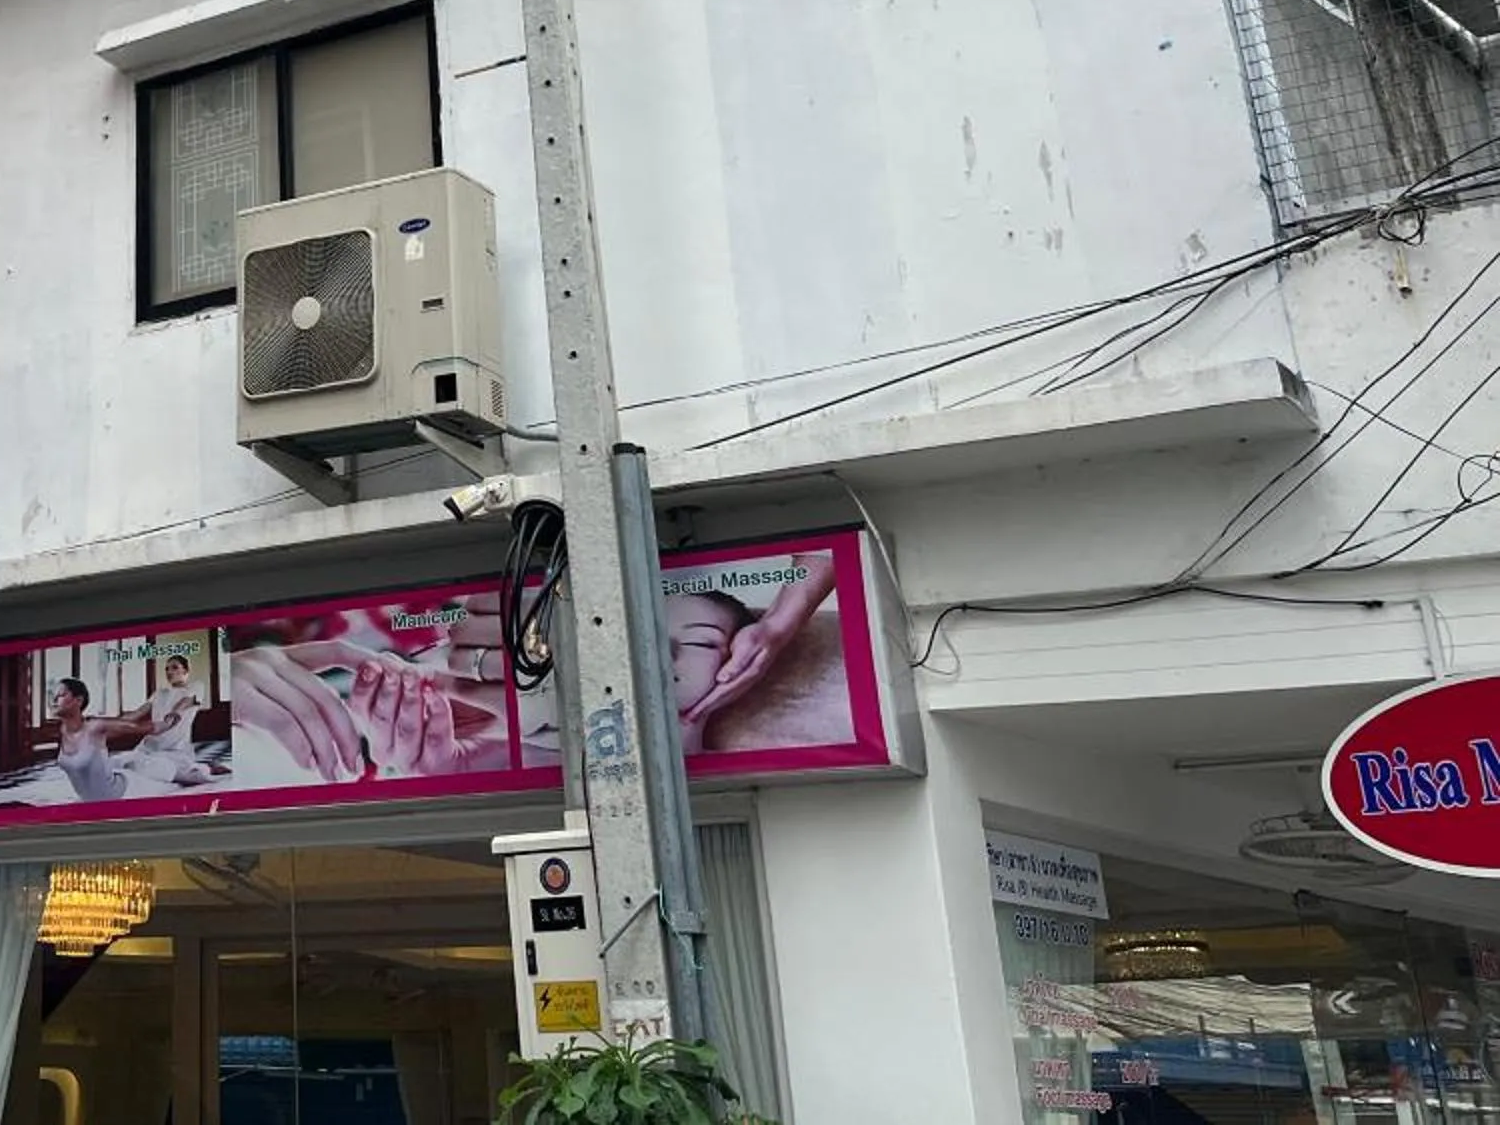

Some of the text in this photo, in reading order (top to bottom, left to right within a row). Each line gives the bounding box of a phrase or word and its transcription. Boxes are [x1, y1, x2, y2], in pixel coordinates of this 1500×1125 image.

[720, 565, 808, 588] Massage
[392, 607, 468, 630] Manicure
[106, 640, 200, 662] Thai Massage
[1349, 746, 1471, 817] Risa
[1063, 1089, 1113, 1114] massage
